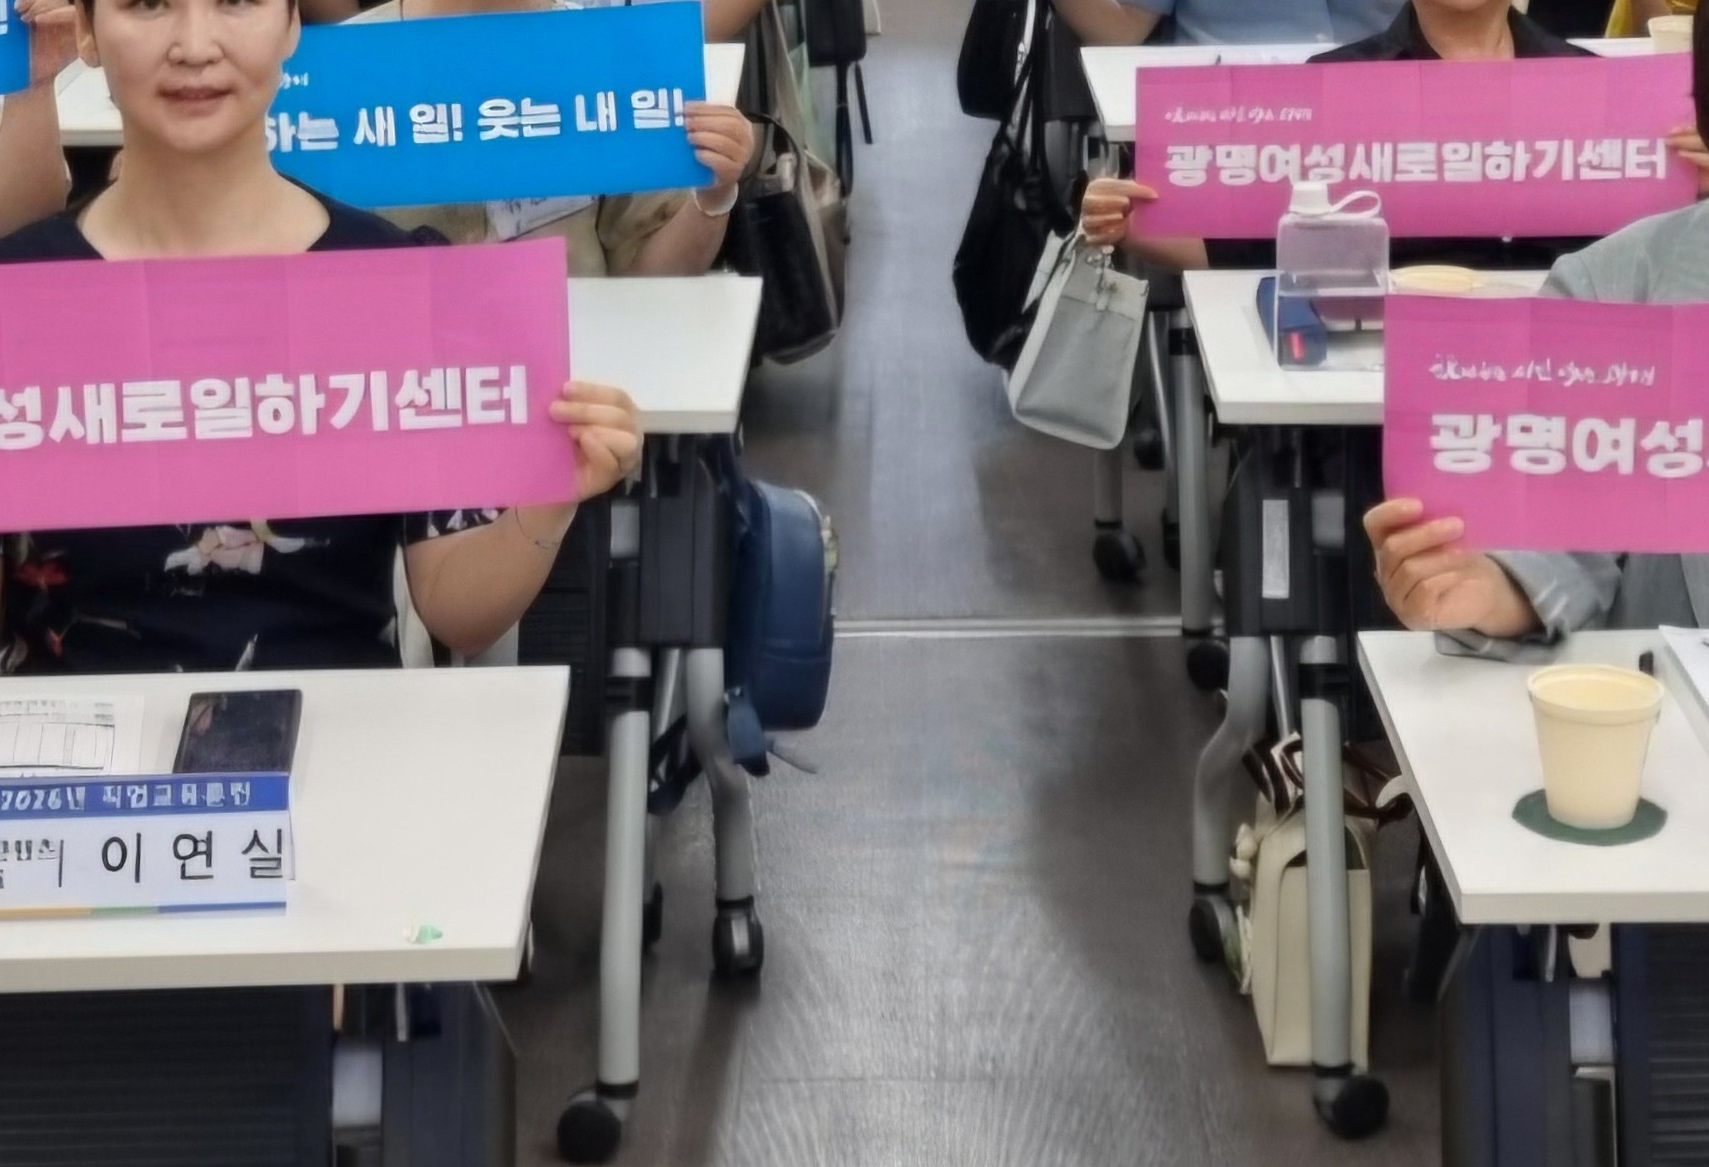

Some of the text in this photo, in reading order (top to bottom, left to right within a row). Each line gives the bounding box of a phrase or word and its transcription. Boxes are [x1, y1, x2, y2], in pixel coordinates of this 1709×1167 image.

[265, 89, 683, 153] 하는 새 일! 웃는 내 일!
[1165, 138, 1667, 186] 광명여성새로일하기센터
[101, 827, 284, 885] 이연실
